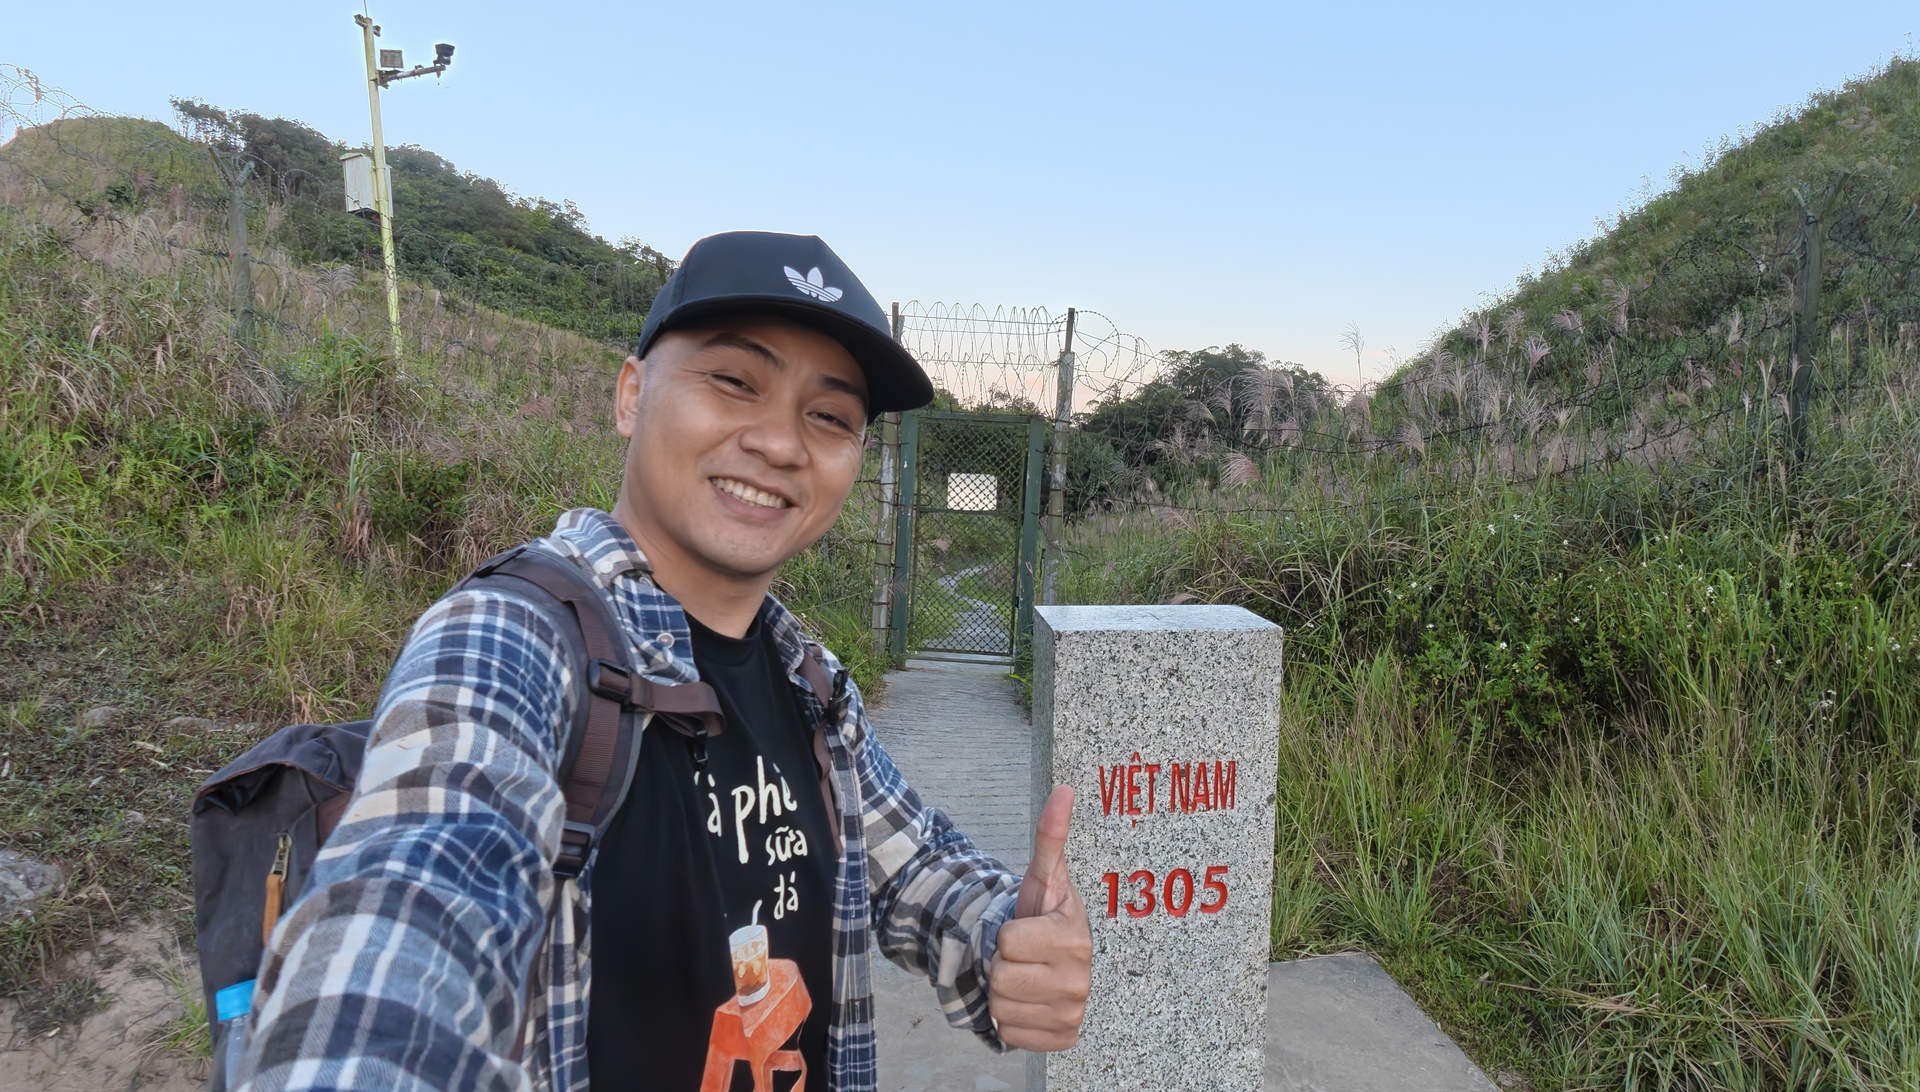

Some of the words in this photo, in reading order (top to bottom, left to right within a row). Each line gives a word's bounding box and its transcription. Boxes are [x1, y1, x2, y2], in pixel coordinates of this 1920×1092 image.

[1099, 751, 1161, 829] VIỆT
[1170, 760, 1236, 814] NAM
[765, 825, 808, 866] sữa
[773, 871, 799, 920] đá
[1101, 866, 1229, 919] 1305
